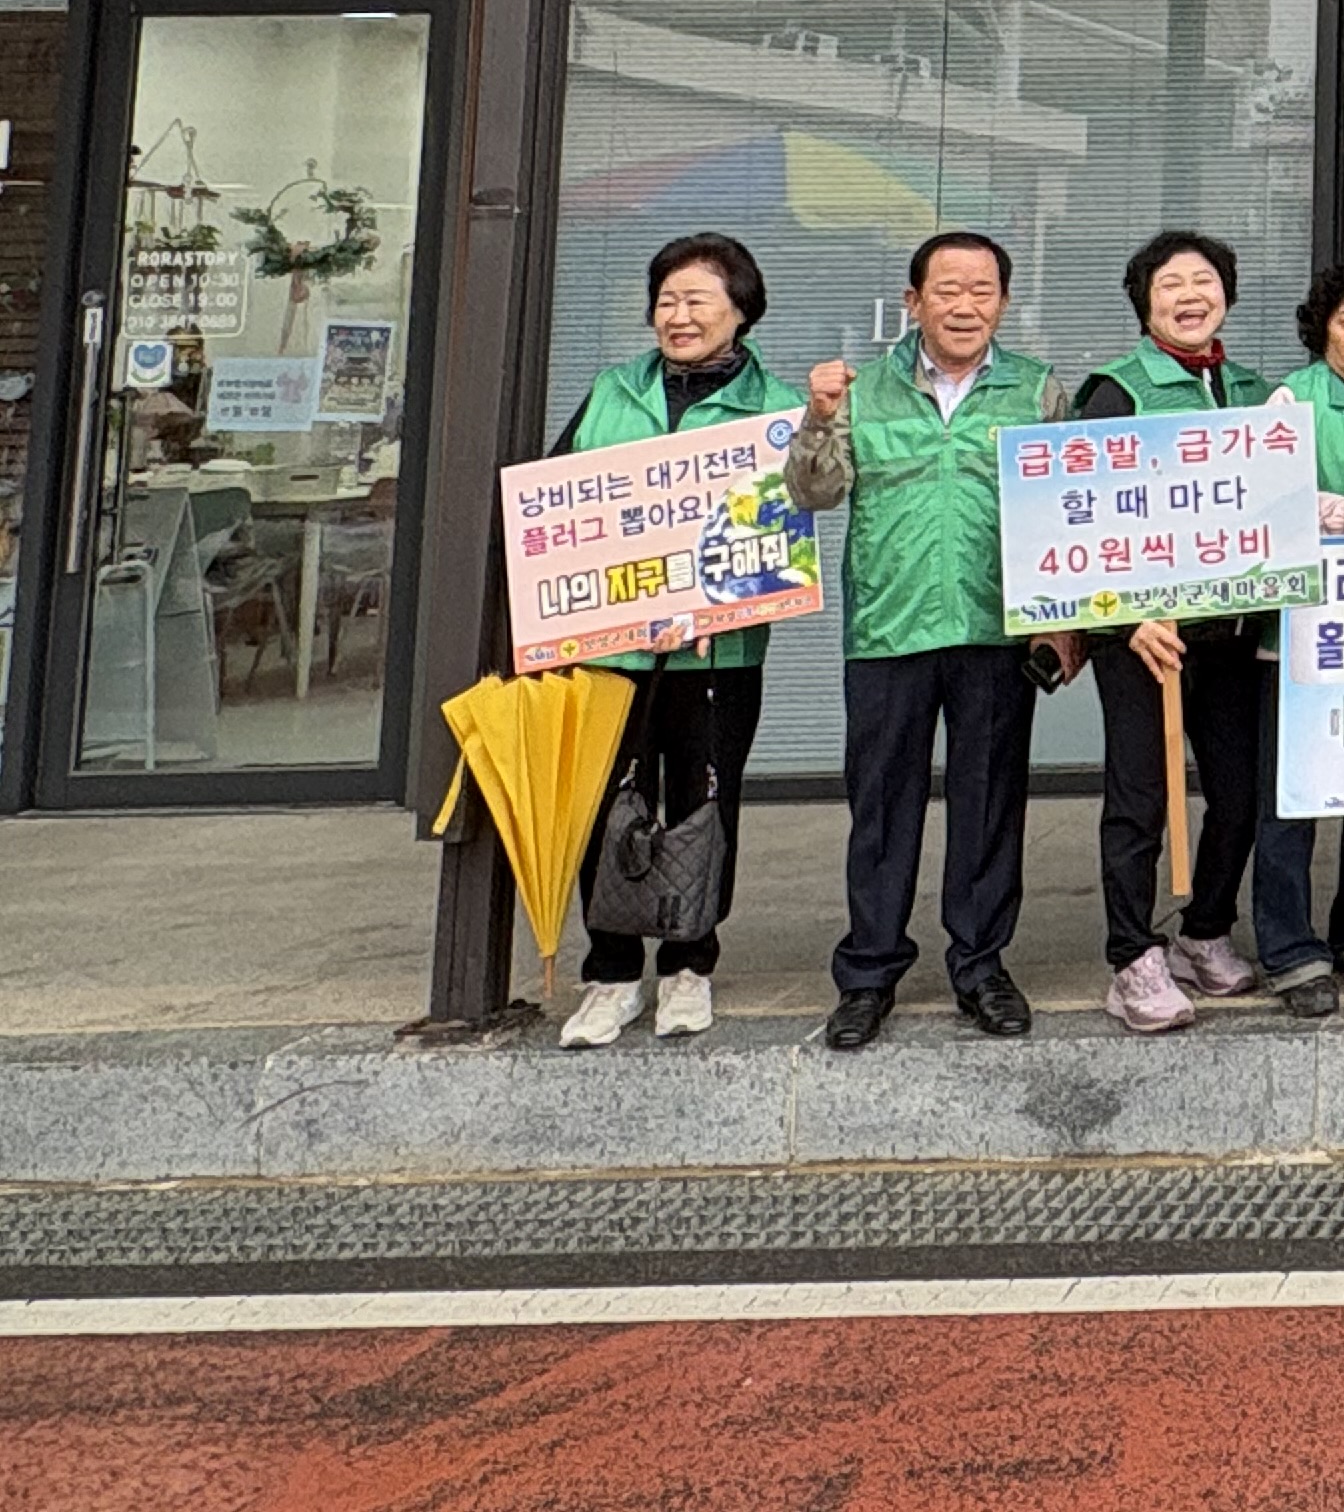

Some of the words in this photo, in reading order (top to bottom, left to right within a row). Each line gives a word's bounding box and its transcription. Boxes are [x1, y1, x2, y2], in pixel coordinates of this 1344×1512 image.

[1016, 434, 1159, 478] 급출발,
[1176, 421, 1299, 465] 급가속
[518, 471, 634, 518] 낭비되는
[645, 443, 758, 490] 대기전력
[1061, 489, 1098, 526] 할
[1116, 485, 1149, 519] 때
[1169, 475, 1248, 514] 마다
[521, 516, 609, 558] 플러그
[618, 490, 714, 537] 뽑아요!
[1038, 532, 1176, 576] 40원씩
[1195, 524, 1271, 565] 낭비
[537, 569, 600, 620] 나의
[604, 549, 696, 605] 지구를
[702, 530, 791, 583] 구해줘
[1131, 572, 1308, 611] 보성군새마을회
[1019, 598, 1078, 623] SMU
